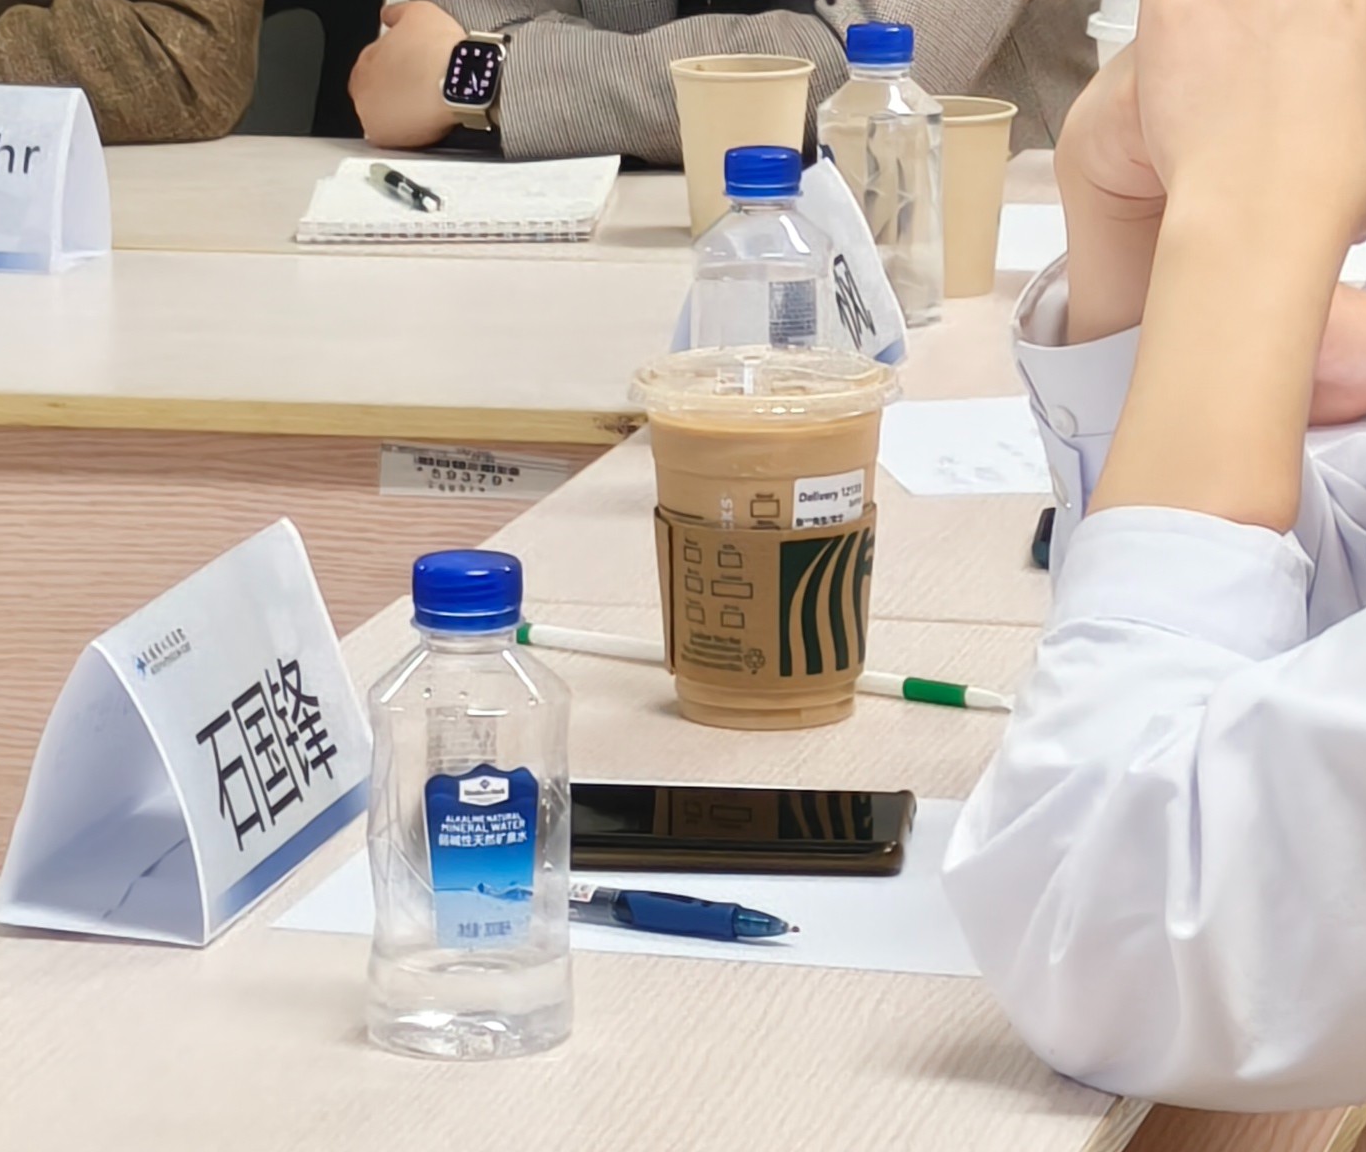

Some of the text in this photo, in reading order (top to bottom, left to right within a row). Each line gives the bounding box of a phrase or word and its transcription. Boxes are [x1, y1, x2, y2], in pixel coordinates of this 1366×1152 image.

[798, 491, 839, 504] Delivery
[195, 658, 338, 852] 石国锋
[441, 819, 527, 833] MINERAL WATER
